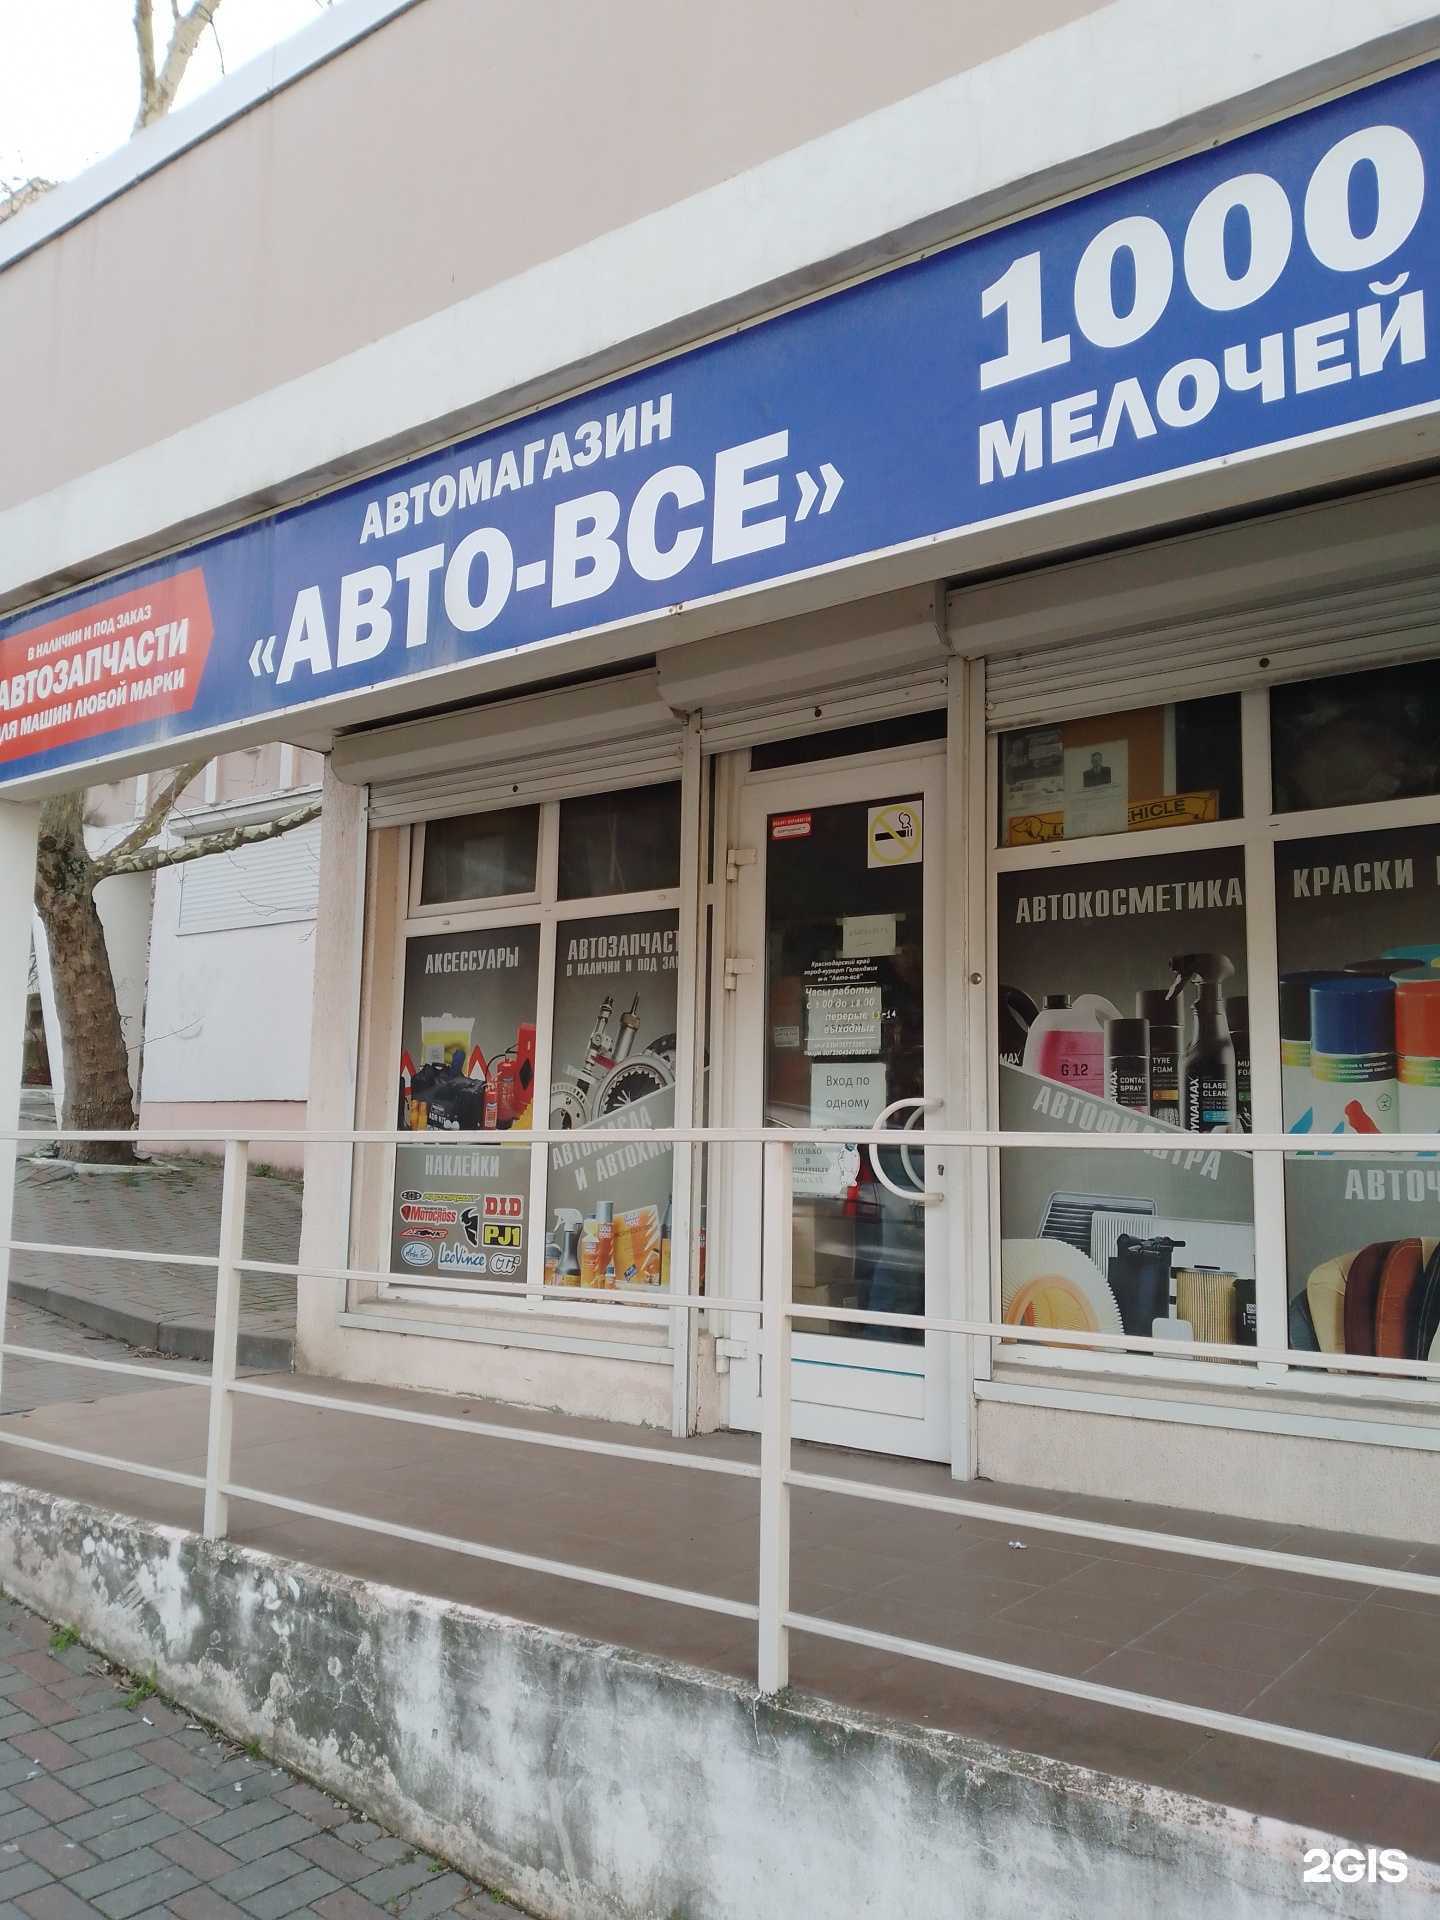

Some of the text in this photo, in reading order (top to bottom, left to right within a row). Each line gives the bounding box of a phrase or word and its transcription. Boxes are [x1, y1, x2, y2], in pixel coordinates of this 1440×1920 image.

[980, 125, 1425, 391] 1000
[979, 272, 1426, 485] МЕЛОЧЕЙ
[359, 392, 673, 544] АВТОМАГАЗИН
[28, 605, 152, 661] В НАЛИЧИИ И ПОД ЗАКАЗ
[0, 618, 189, 711] АВТОЗАПЧАСТИ
[0, 668, 185, 746] ЛЯ МАШИН ЛЮБОЙ МАРКИ
[1128, 799, 1185, 823] HICLE
[1293, 858, 1414, 898] КРАСКИ
[1016, 877, 1244, 924] АВТОКОСМЕТИКА
[425, 946, 519, 975] АКСЕССУАРЫ
[577, 960, 620, 976] НАЛИЧИИ
[625, 959, 632, 973] И
[637, 957, 658, 972] ПОД
[826, 1075, 870, 1088] Вход по
[826, 1099, 870, 1111] одному
[425, 1152, 500, 1178] НАКЛЕЙКИ
[574, 1167, 588, 1191] И
